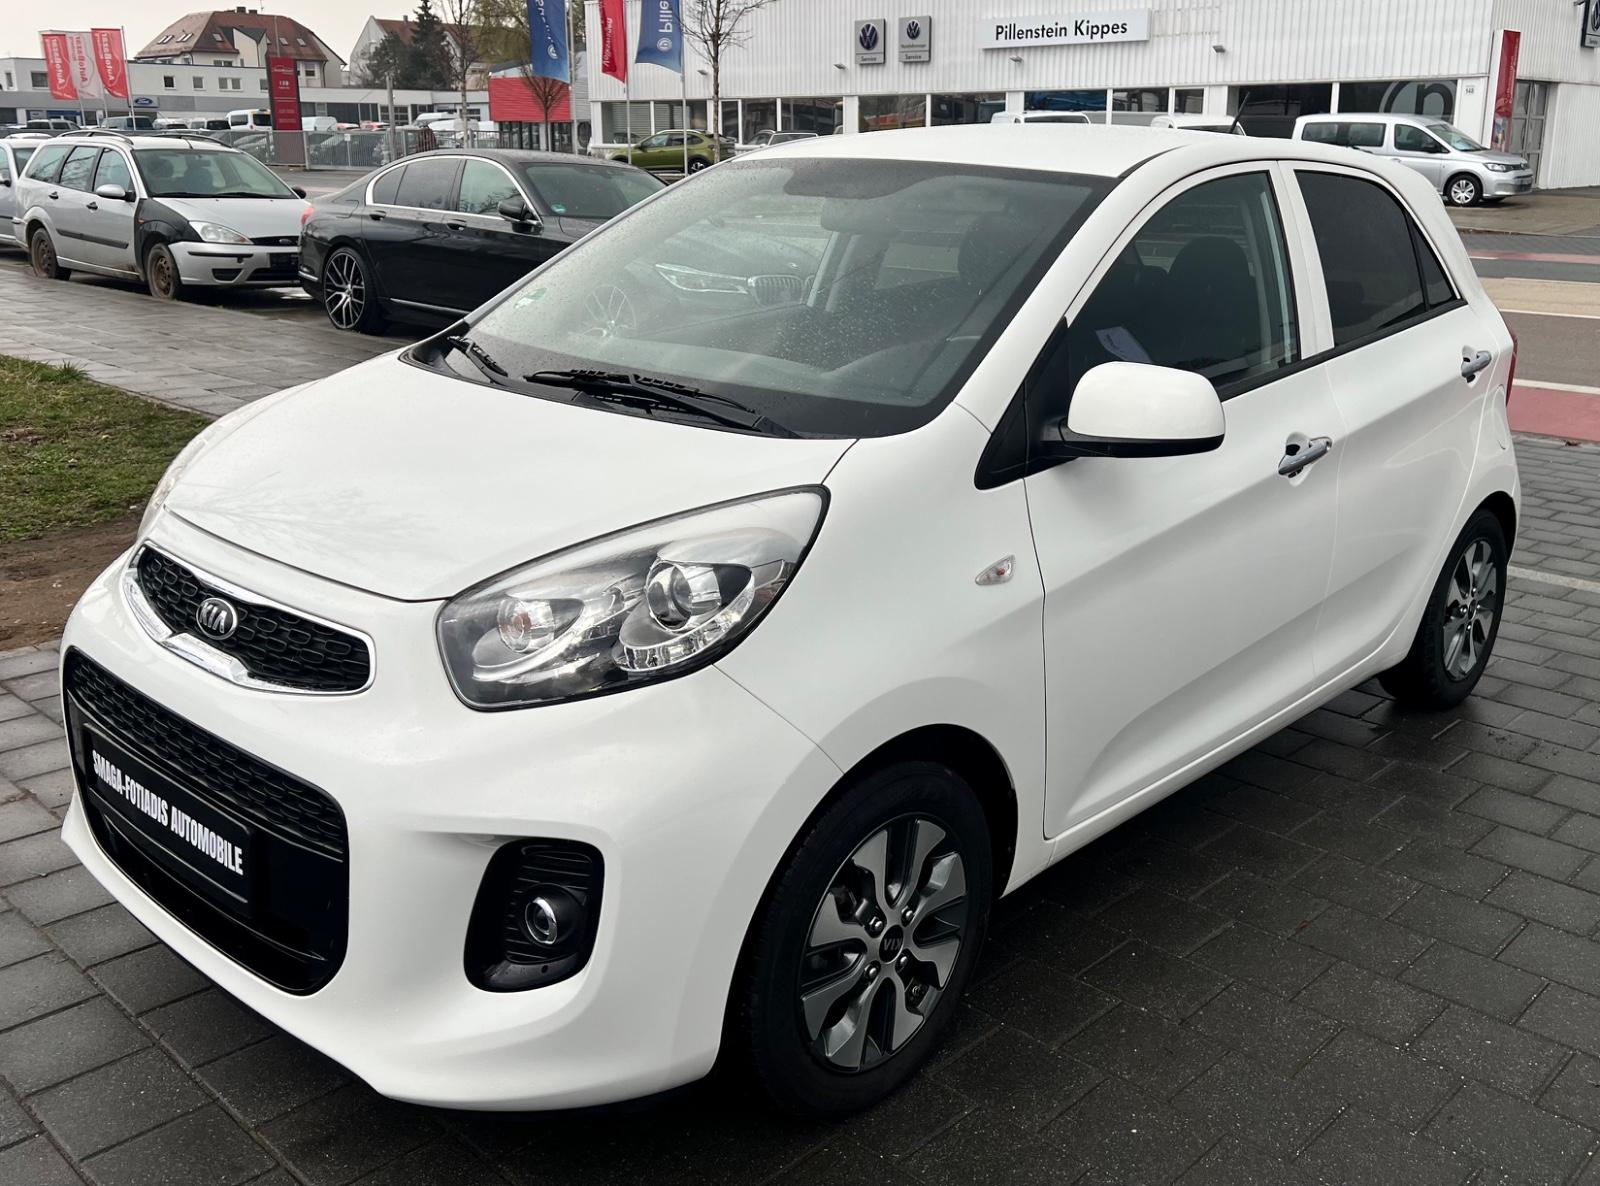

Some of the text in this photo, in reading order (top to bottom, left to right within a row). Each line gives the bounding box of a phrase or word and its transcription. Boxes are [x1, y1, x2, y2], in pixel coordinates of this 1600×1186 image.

[995, 19, 1128, 41] Pillenstein Kippes
[199, 602, 228, 634] KIA
[92, 750, 244, 876] SMAGA-FOTIADIS AUTOMOBILE
